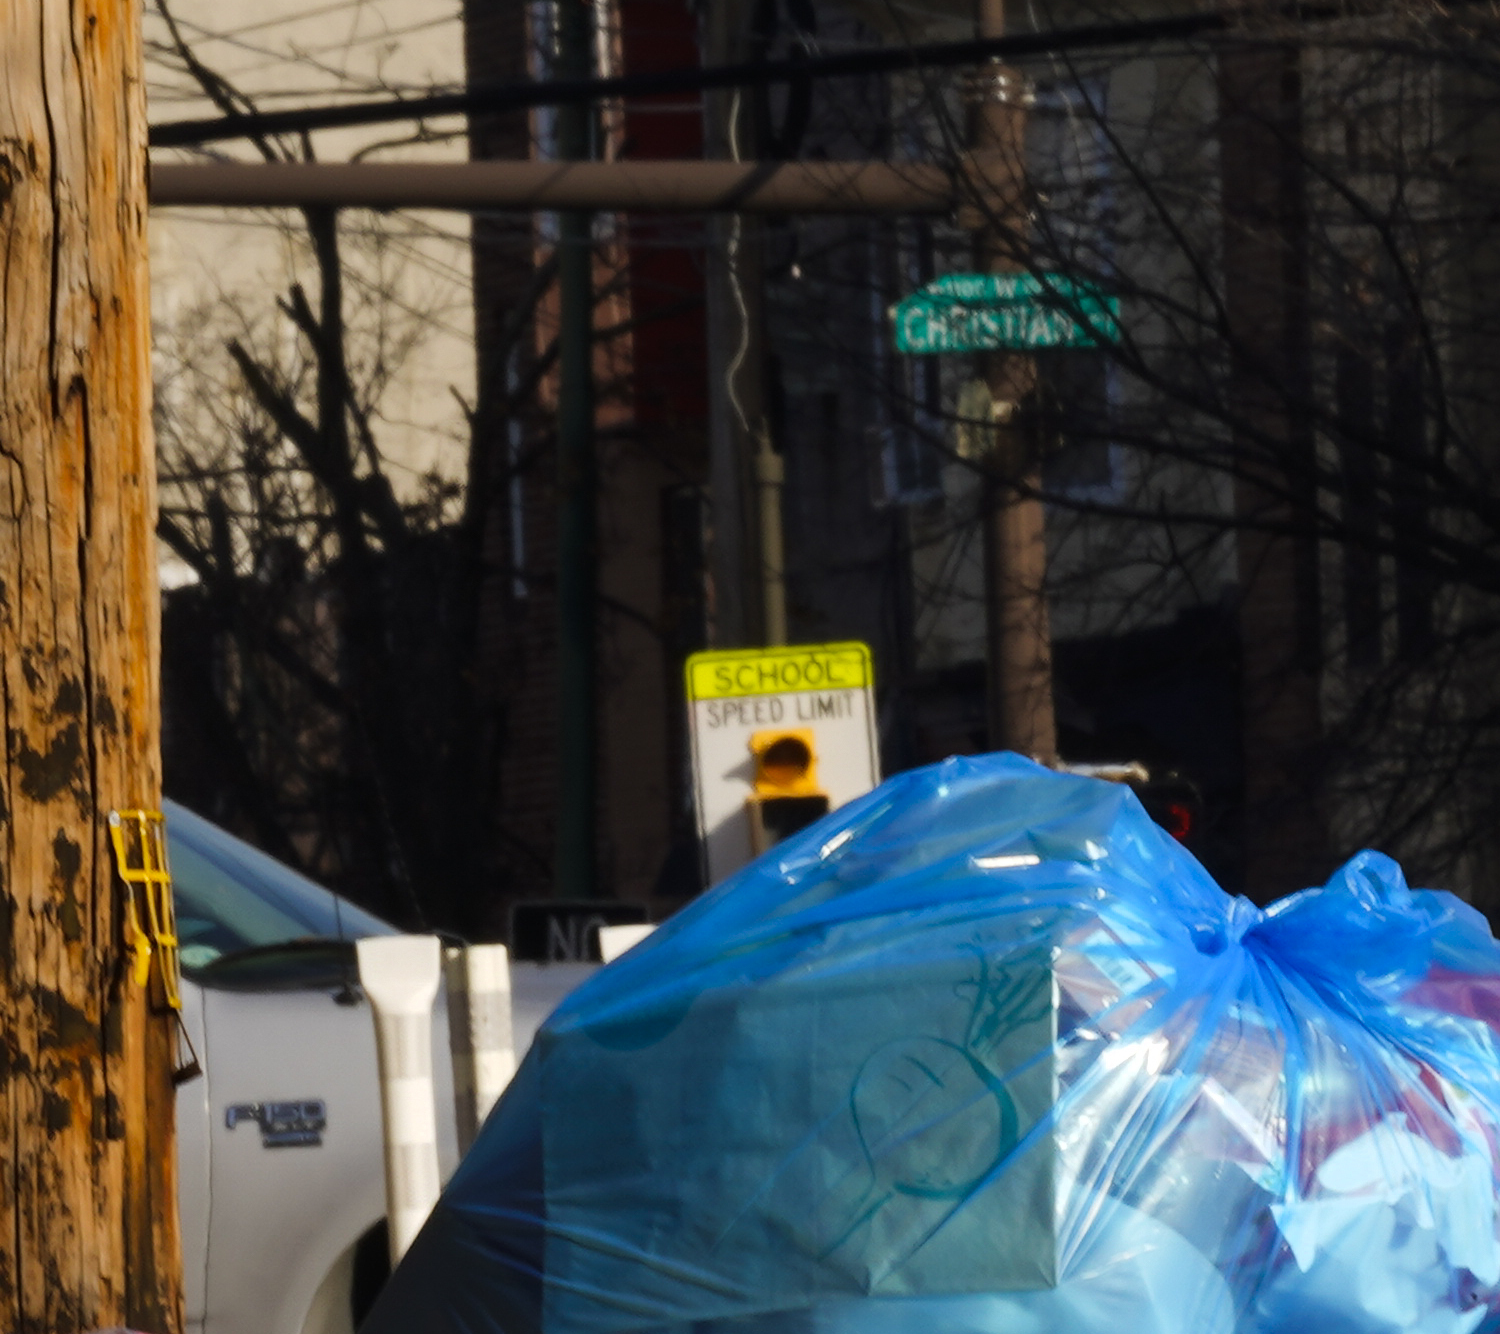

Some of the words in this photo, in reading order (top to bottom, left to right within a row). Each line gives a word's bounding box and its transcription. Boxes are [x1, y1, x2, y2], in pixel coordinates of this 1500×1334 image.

[714, 657, 845, 693] SCHOOL
[706, 696, 784, 729] SPEED
[796, 691, 855, 723] LIMIT
